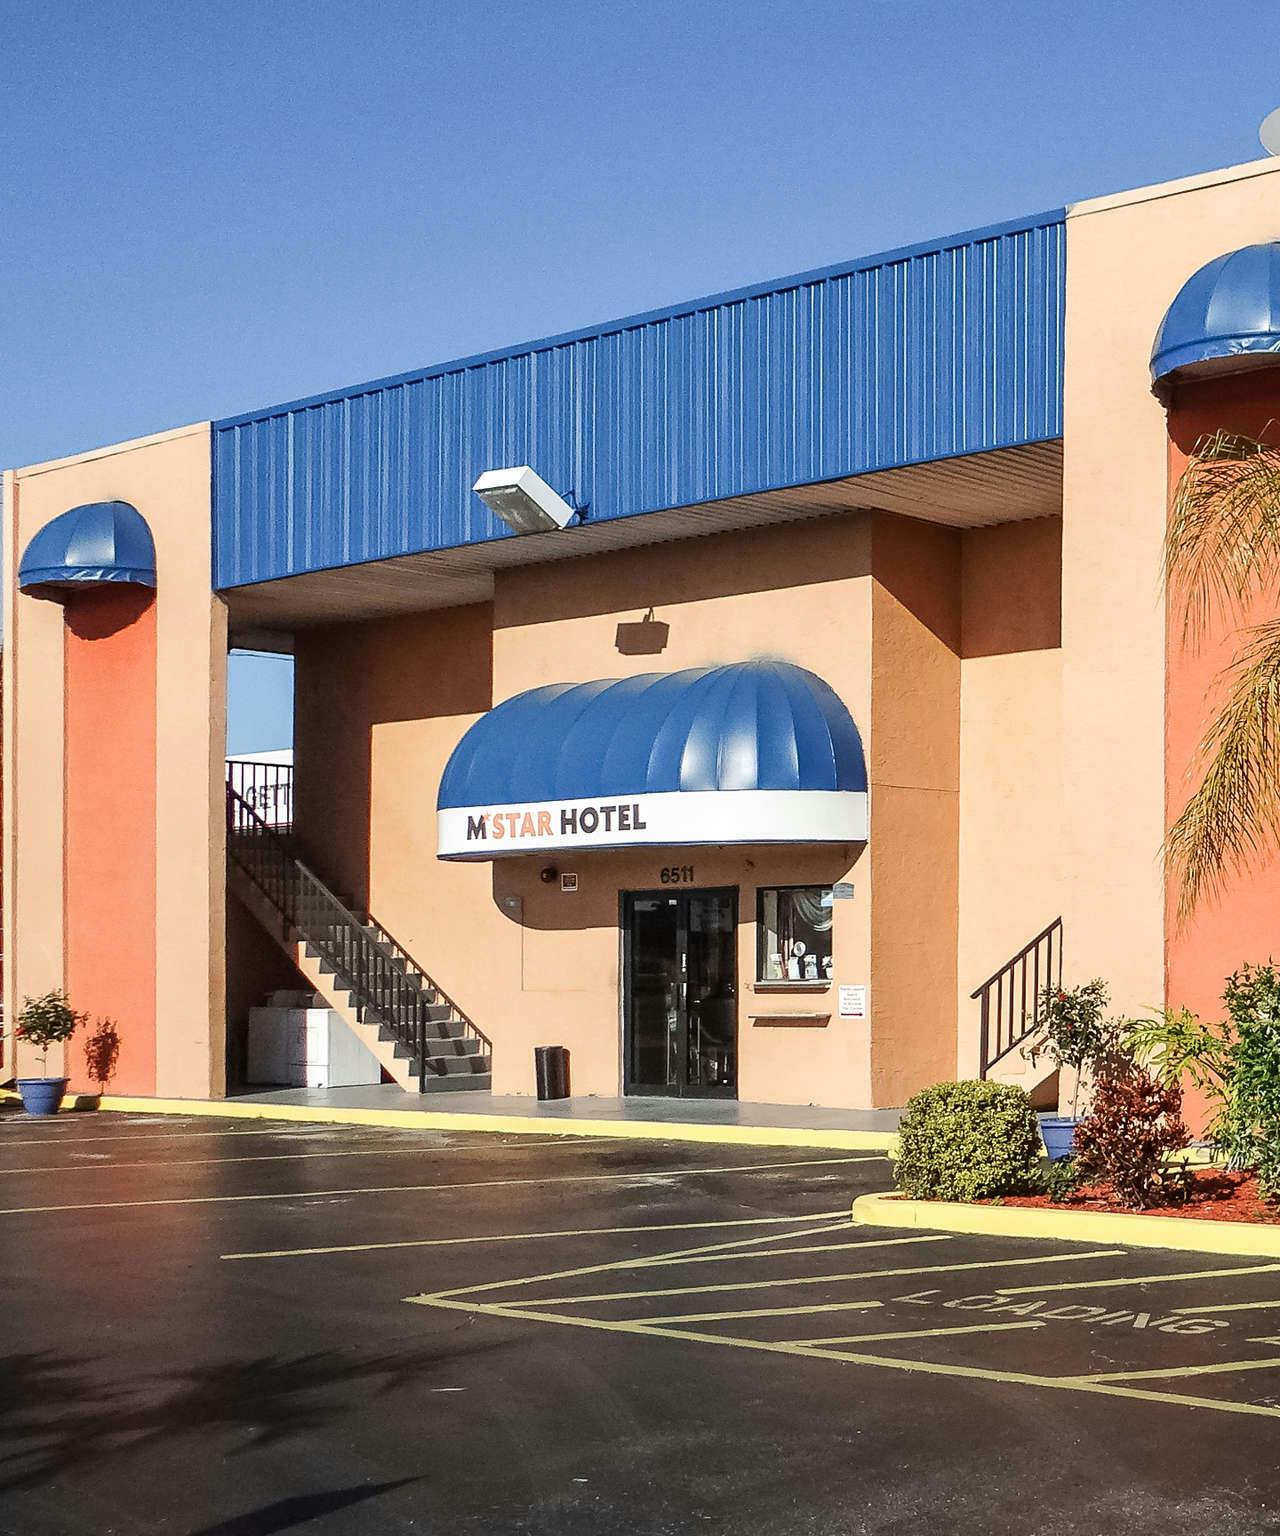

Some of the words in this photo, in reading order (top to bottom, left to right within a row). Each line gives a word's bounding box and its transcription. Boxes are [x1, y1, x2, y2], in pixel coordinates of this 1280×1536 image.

[560, 803, 647, 835] HOTEL
[660, 865, 695, 884] 6511
[890, 1289, 1230, 1334] LOADING
